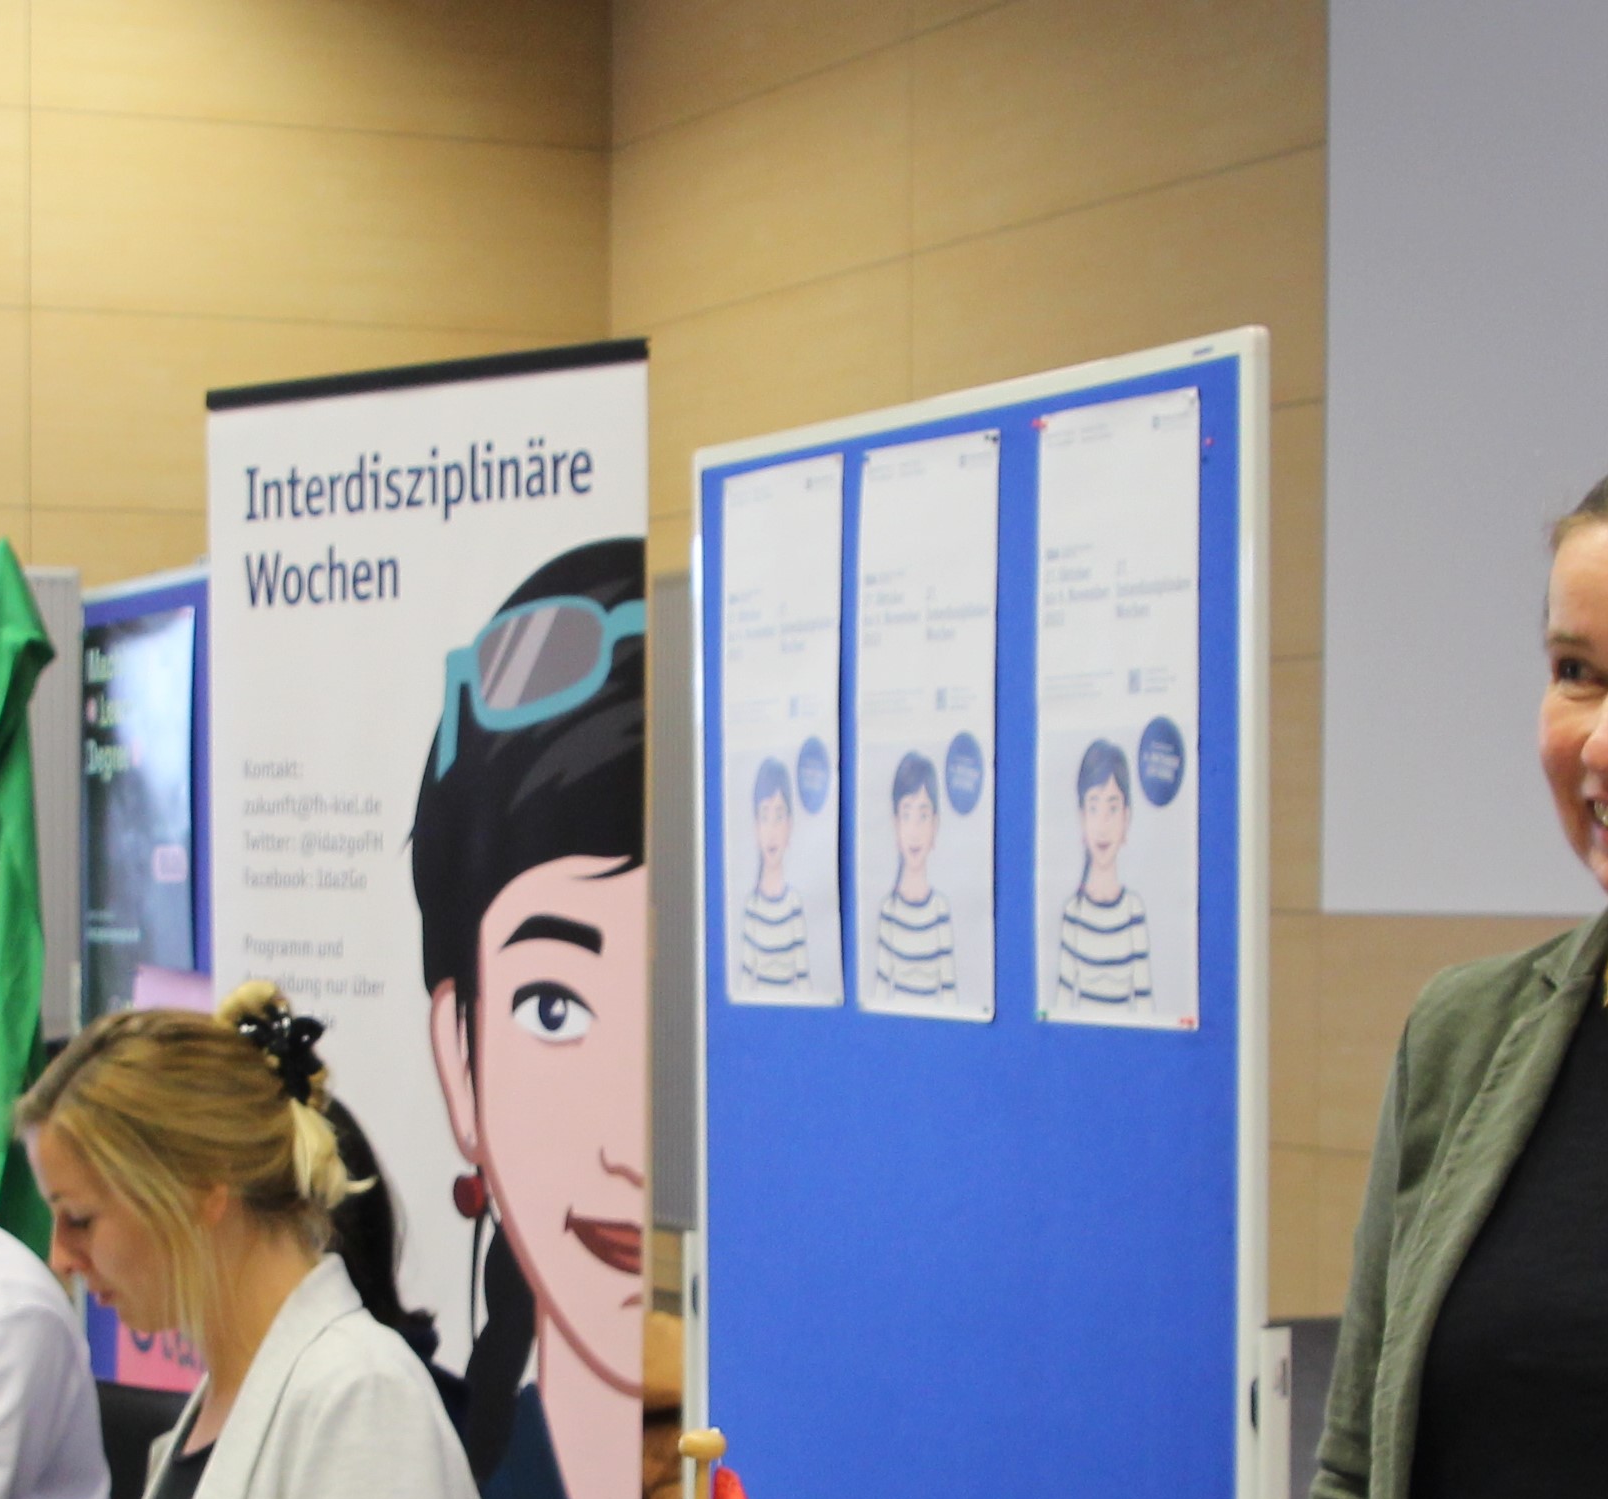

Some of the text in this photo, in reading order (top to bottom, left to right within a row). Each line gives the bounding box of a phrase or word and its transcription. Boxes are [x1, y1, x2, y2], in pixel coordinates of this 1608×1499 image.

[245, 438, 593, 521] Interdisziplinäre
[245, 545, 401, 608] Wochen
[245, 935, 343, 961] Programm und
